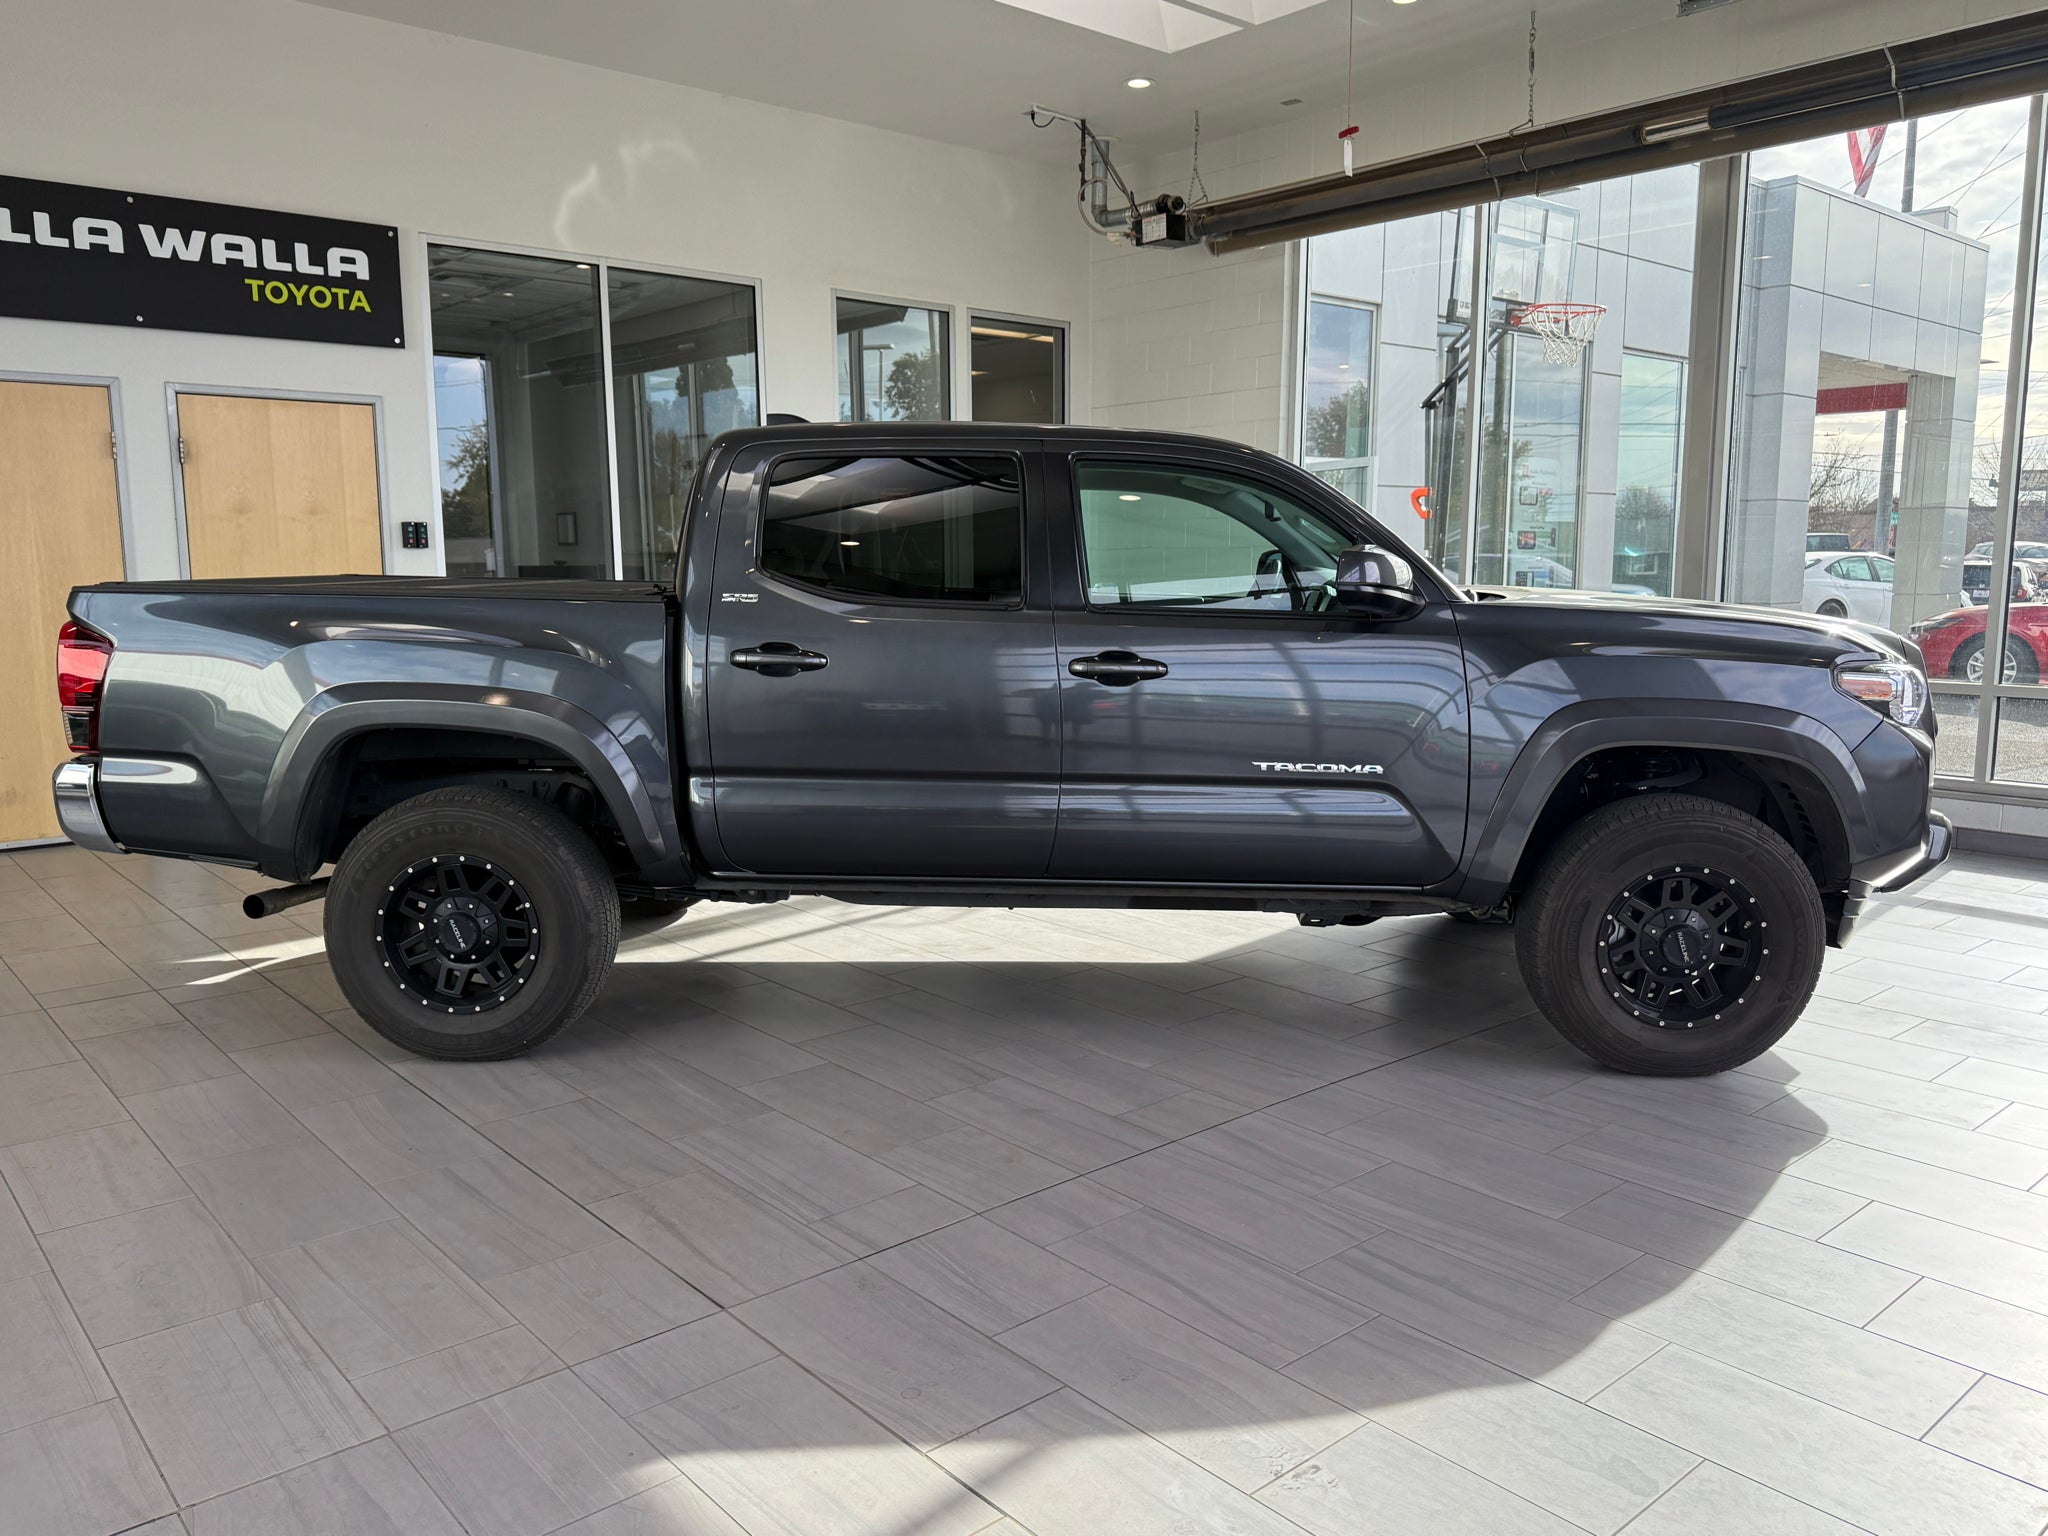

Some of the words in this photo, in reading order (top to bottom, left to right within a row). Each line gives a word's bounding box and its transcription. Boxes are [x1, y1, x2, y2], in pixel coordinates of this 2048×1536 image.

[139, 223, 370, 281] WALLA
[244, 278, 372, 313] TOYOTA
[1252, 761, 1384, 775] TACOMA
